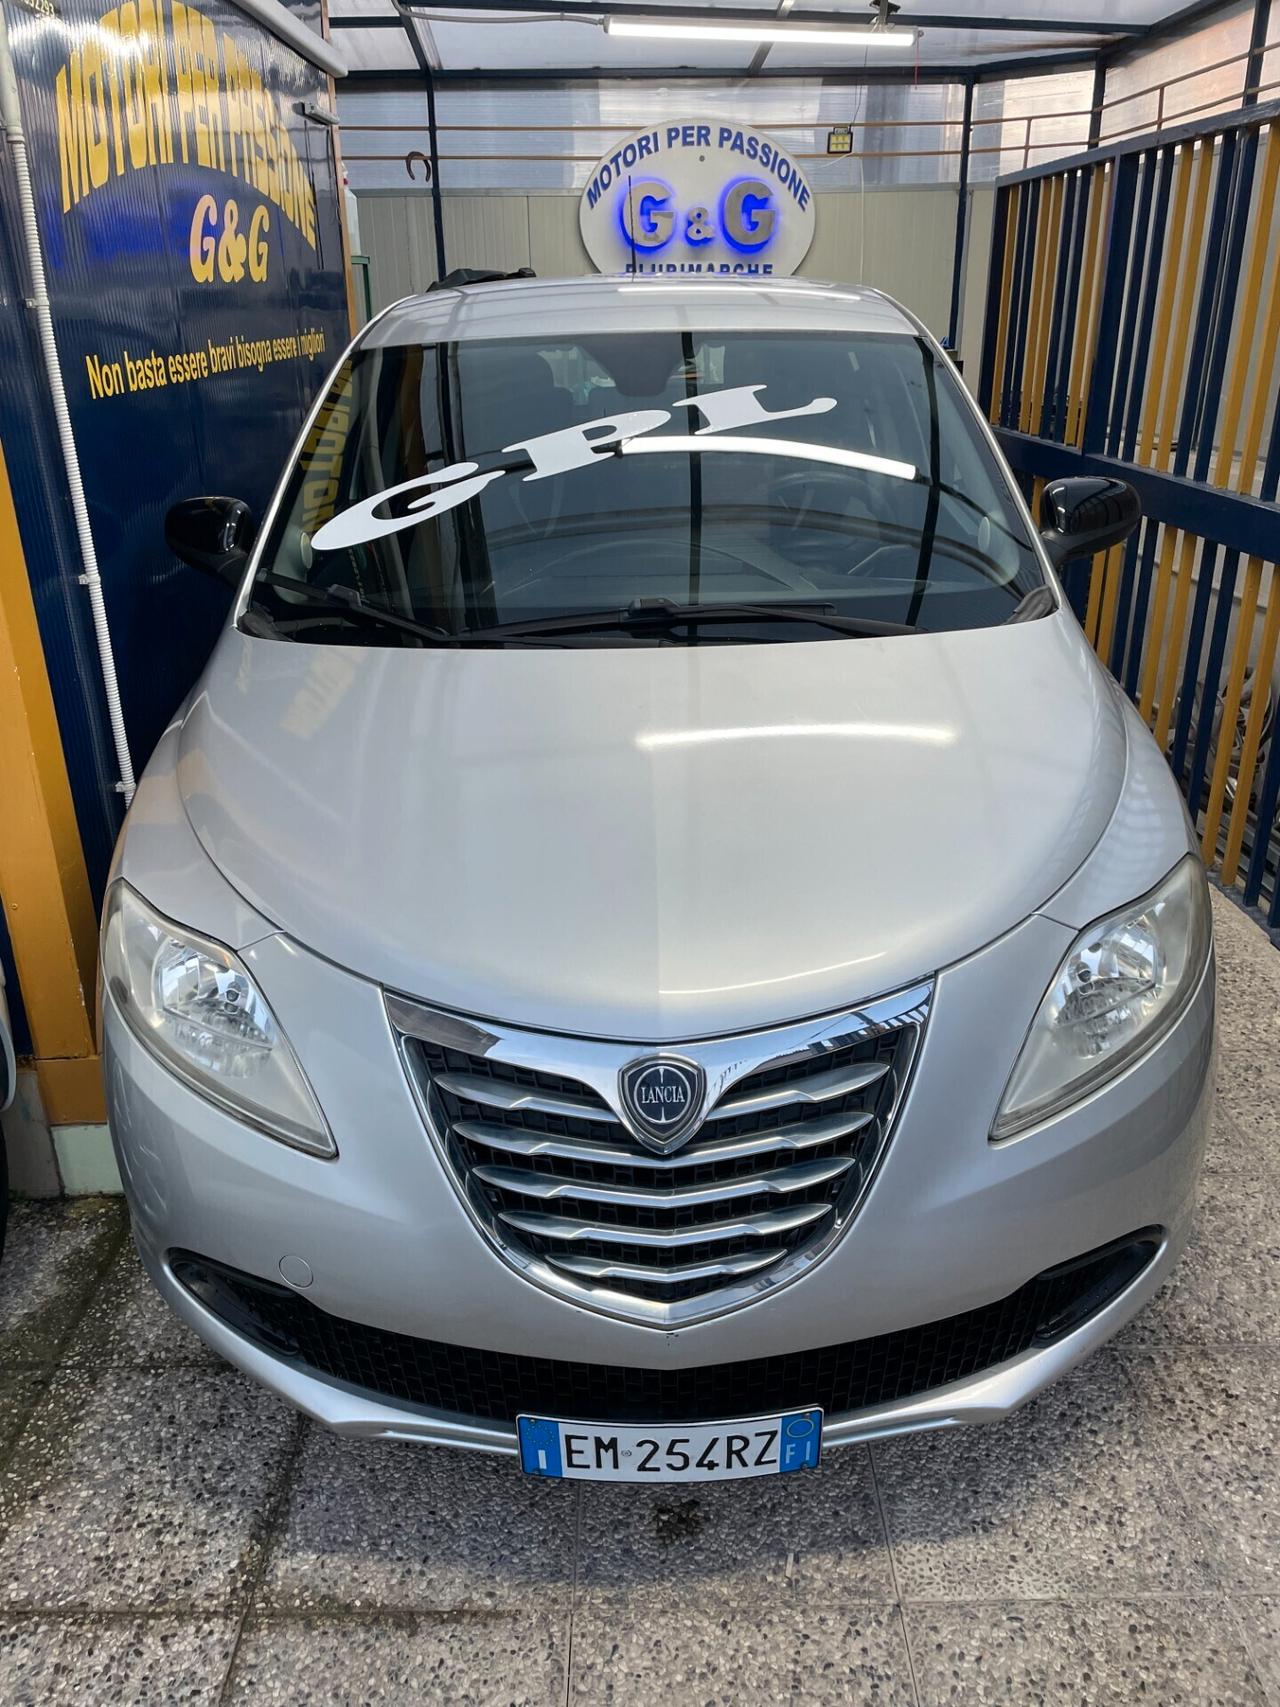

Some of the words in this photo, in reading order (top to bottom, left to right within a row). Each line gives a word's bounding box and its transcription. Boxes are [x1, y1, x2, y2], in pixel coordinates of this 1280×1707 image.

[56, 0, 175, 215] MOTORI
[171, 0, 226, 173] PER
[223, 32, 316, 250] PASSIONE
[586, 132, 660, 210] MOTORI
[666, 125, 711, 148] PER
[718, 127, 811, 212] PASSIONE
[189, 194, 271, 284] G&G
[85, 353, 125, 400] Non
[124, 349, 168, 392] basta
[168, 350, 209, 384] essere
[208, 336, 237, 374] bravi
[235, 335, 273, 372] bisogna
[272, 337, 298, 361] essere
[300, 326, 326, 362] migliori
[311, 384, 838, 550] GPL
[640, 1086, 686, 1104] LANCIA
[538, 1449, 547, 1470] I
[565, 1434, 619, 1470] EM
[636, 1429, 778, 1472] 254RZ
[785, 1441, 811, 1465] FI
